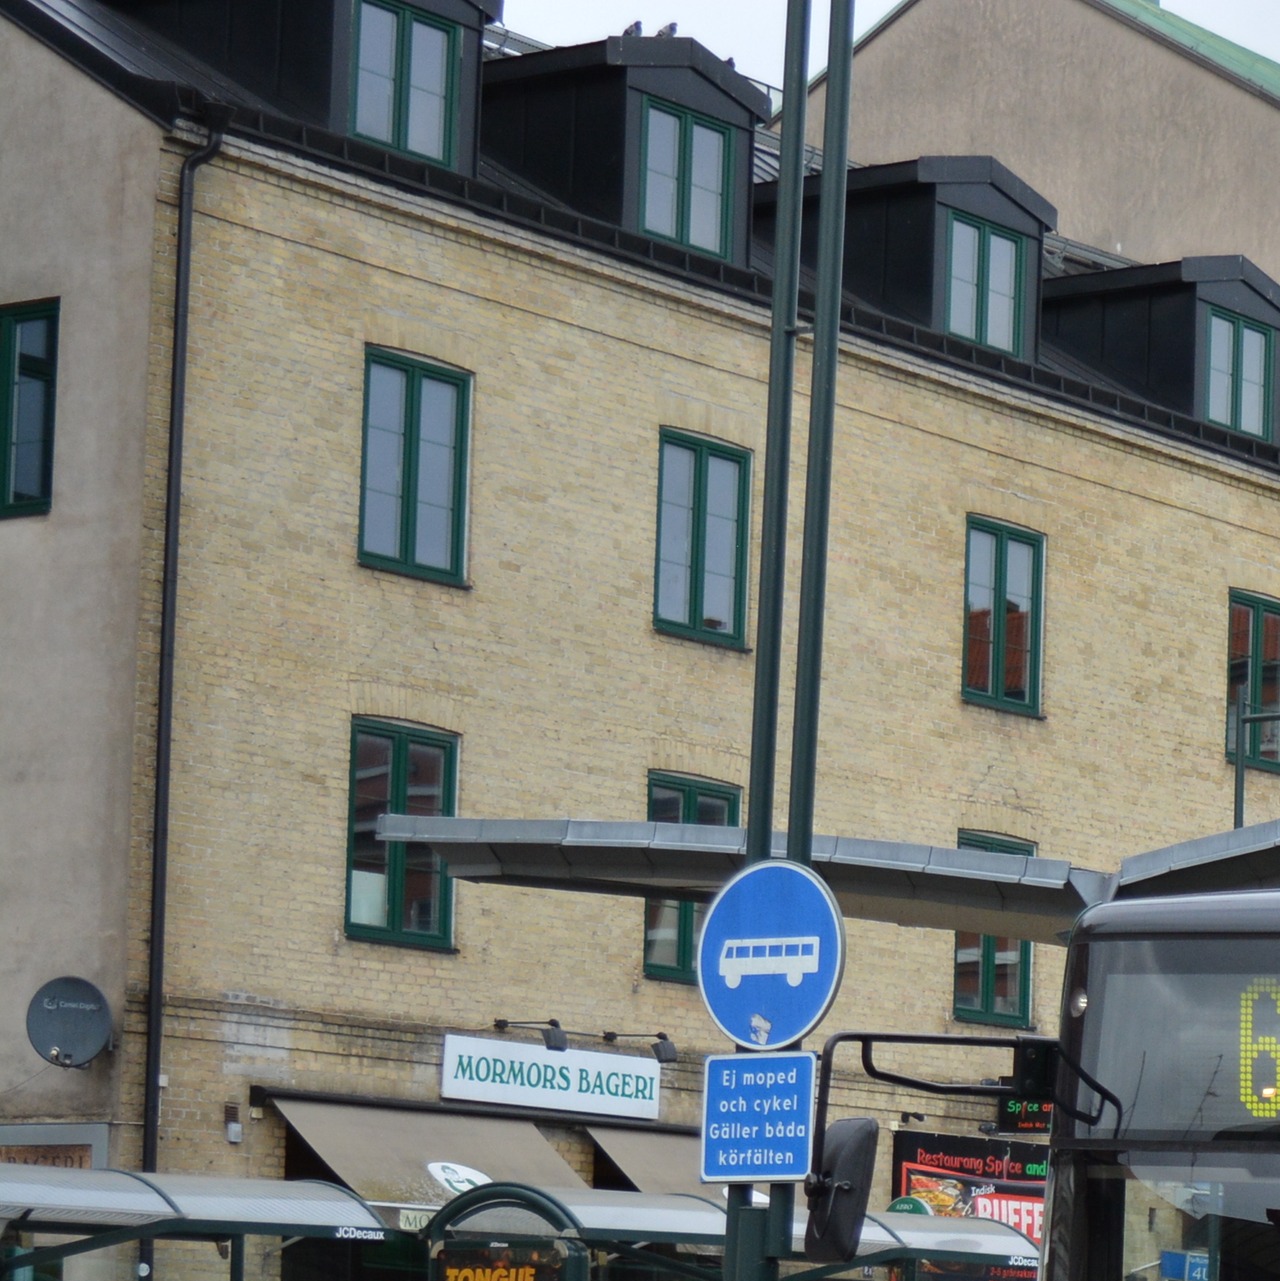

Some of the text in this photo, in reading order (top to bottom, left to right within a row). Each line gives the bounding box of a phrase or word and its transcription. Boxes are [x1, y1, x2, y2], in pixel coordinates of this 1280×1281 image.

[453, 1054, 656, 1100] MORMORS BAGERI
[722, 1067, 797, 1090] Ej moped
[719, 1094, 798, 1115] och cykel
[709, 1121, 806, 1139] Gäller båda
[718, 1148, 794, 1166] körfälten
[917, 1148, 983, 1174] Restaurang
[1026, 1160, 1047, 1176] and
[971, 1184, 996, 1197] Indisk
[335, 1226, 385, 1241] JCDecaux
